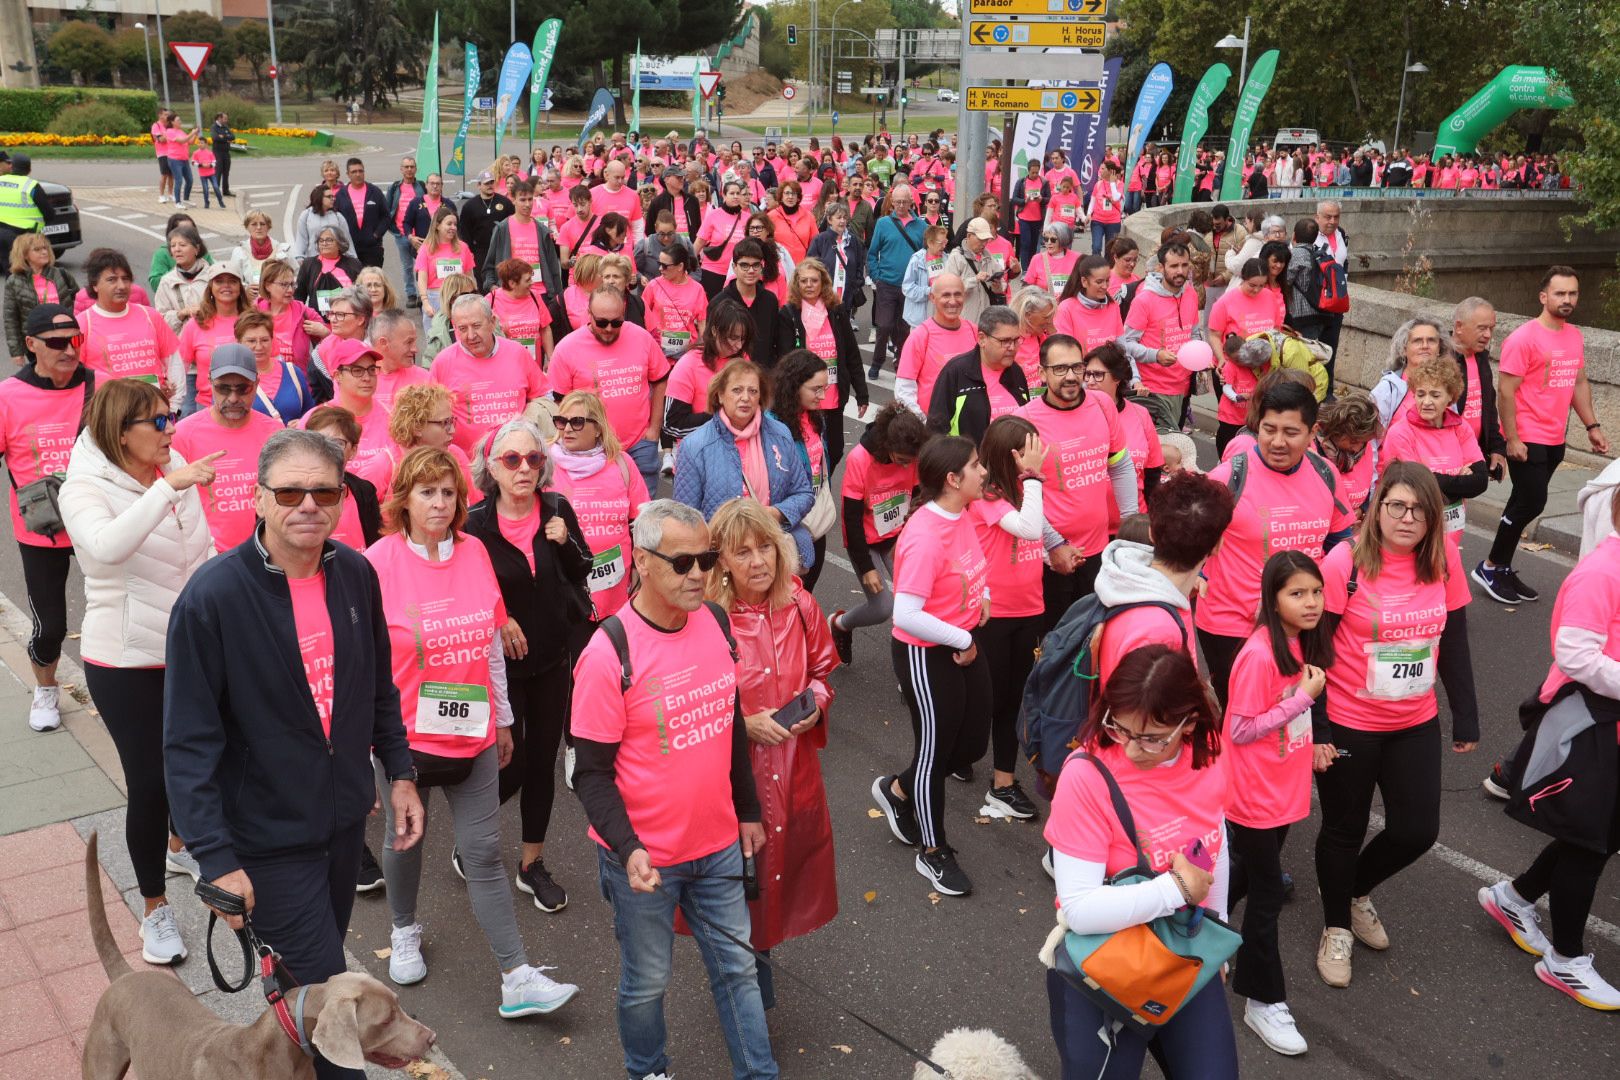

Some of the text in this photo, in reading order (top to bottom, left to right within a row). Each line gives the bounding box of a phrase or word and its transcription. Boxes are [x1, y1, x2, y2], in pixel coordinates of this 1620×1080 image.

[1062, 27, 1102, 35] H. Horus
[1076, 35, 1102, 46] Regio
[982, 91, 1008, 99] Vincci
[969, 100, 1029, 108] H. P. Romano
[107, 338, 155, 352] En marcha
[667, 338, 684, 346] 4870
[110, 346, 155, 361] contra el
[112, 358, 156, 373] cáncer
[597, 364, 643, 377] En marcha
[600, 373, 642, 388] contra el
[470, 389, 519, 401] En marcha
[601, 384, 642, 399] cáncer
[472, 400, 509, 412] contra
[38, 437, 56, 448] En
[1061, 452, 1076, 463] En
[1063, 458, 1105, 476] contra
[215, 472, 230, 484] En
[572, 499, 589, 509] En
[883, 506, 901, 523] 9057
[1270, 516, 1330, 533] En marcha
[1271, 532, 1316, 548] contra
[590, 561, 616, 580] 2691
[422, 607, 495, 632] En marcha
[1382, 610, 1402, 624] En
[1382, 622, 1439, 639] contra
[426, 627, 485, 650] contra
[428, 642, 492, 668] cánce
[1392, 662, 1424, 679] 2740
[665, 694, 686, 711] En
[687, 671, 736, 702] marcha
[438, 700, 470, 718] 586
[668, 697, 726, 730] contra
